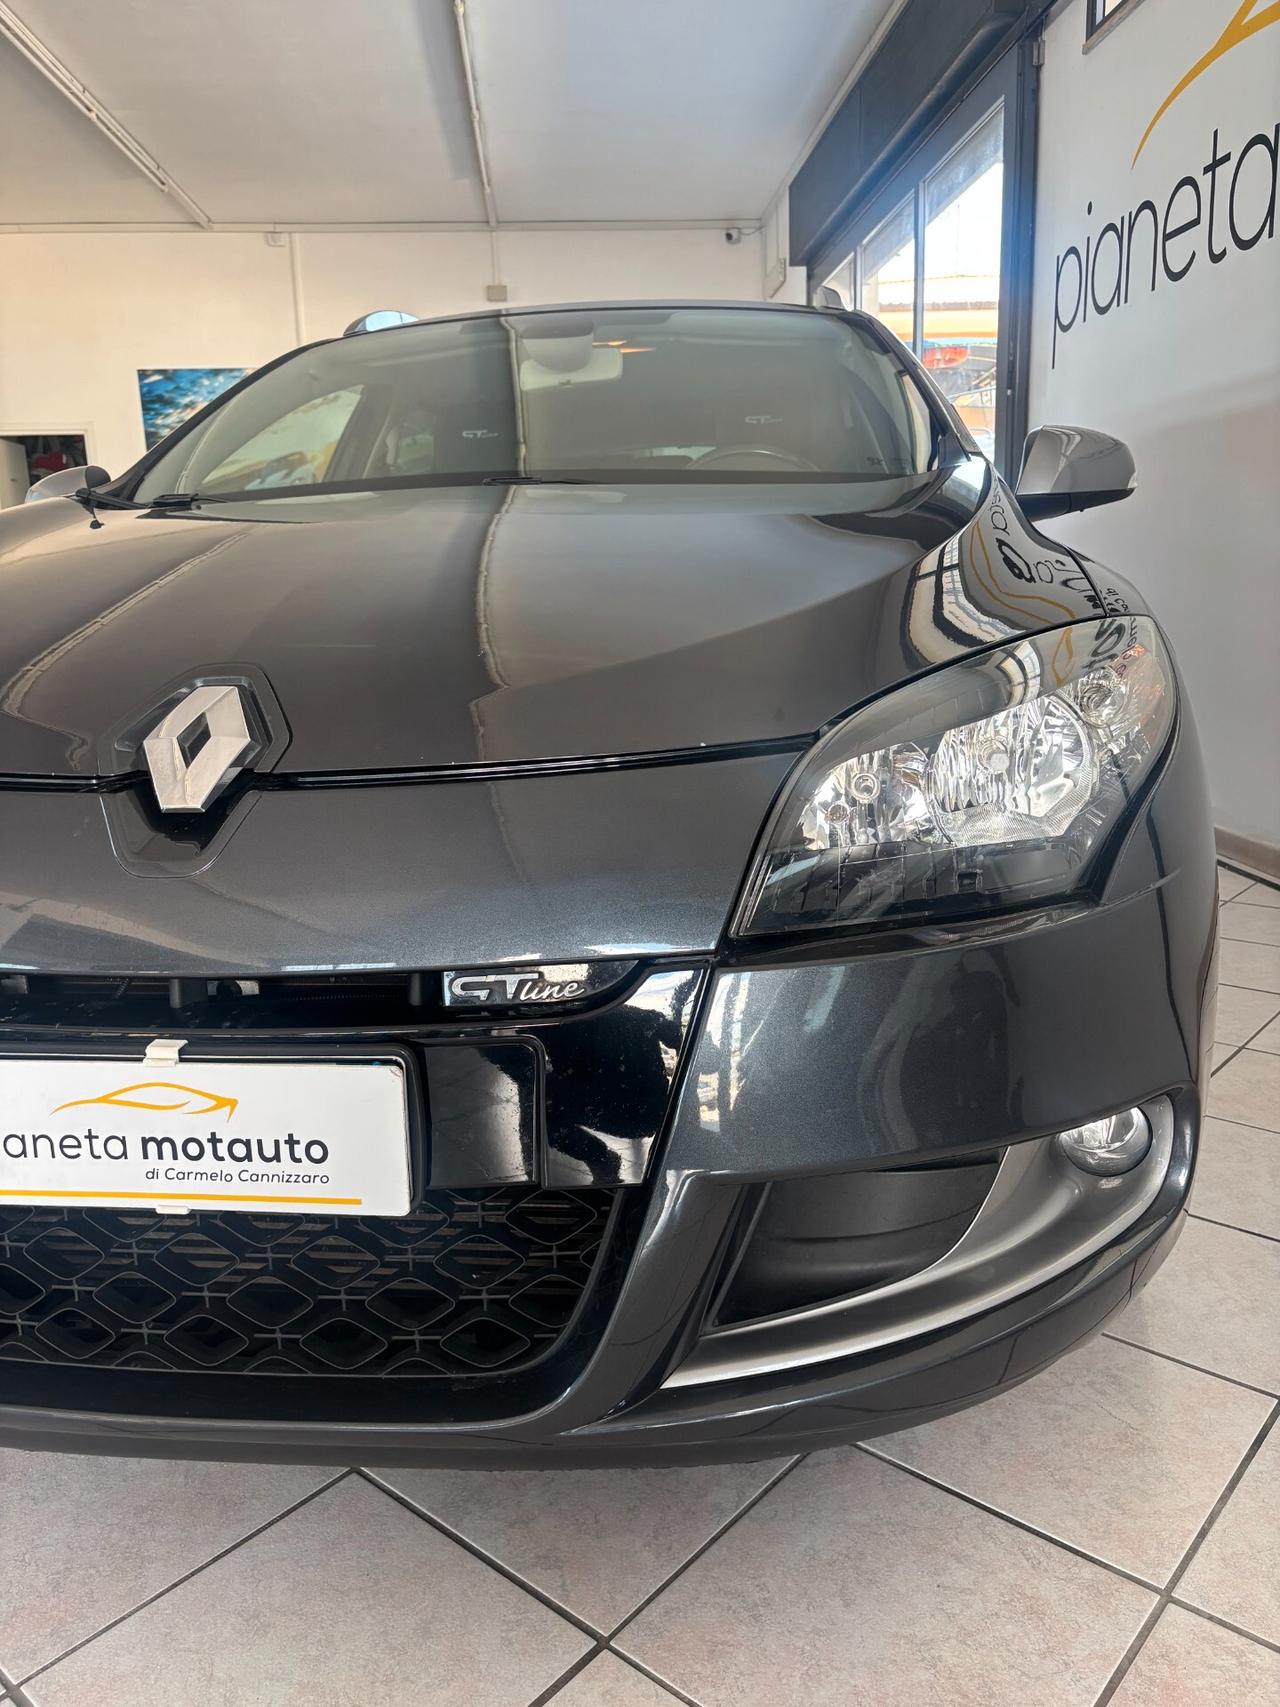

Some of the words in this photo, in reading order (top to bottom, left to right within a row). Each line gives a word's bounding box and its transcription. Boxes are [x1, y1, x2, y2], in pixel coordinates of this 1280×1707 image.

[1052, 122, 1280, 370] pianeta
[141, 1131, 329, 1165] motauto
[145, 1168, 160, 1180] di
[164, 1168, 233, 1183] Carmelo
[238, 1169, 330, 1185] Cannizzaro
